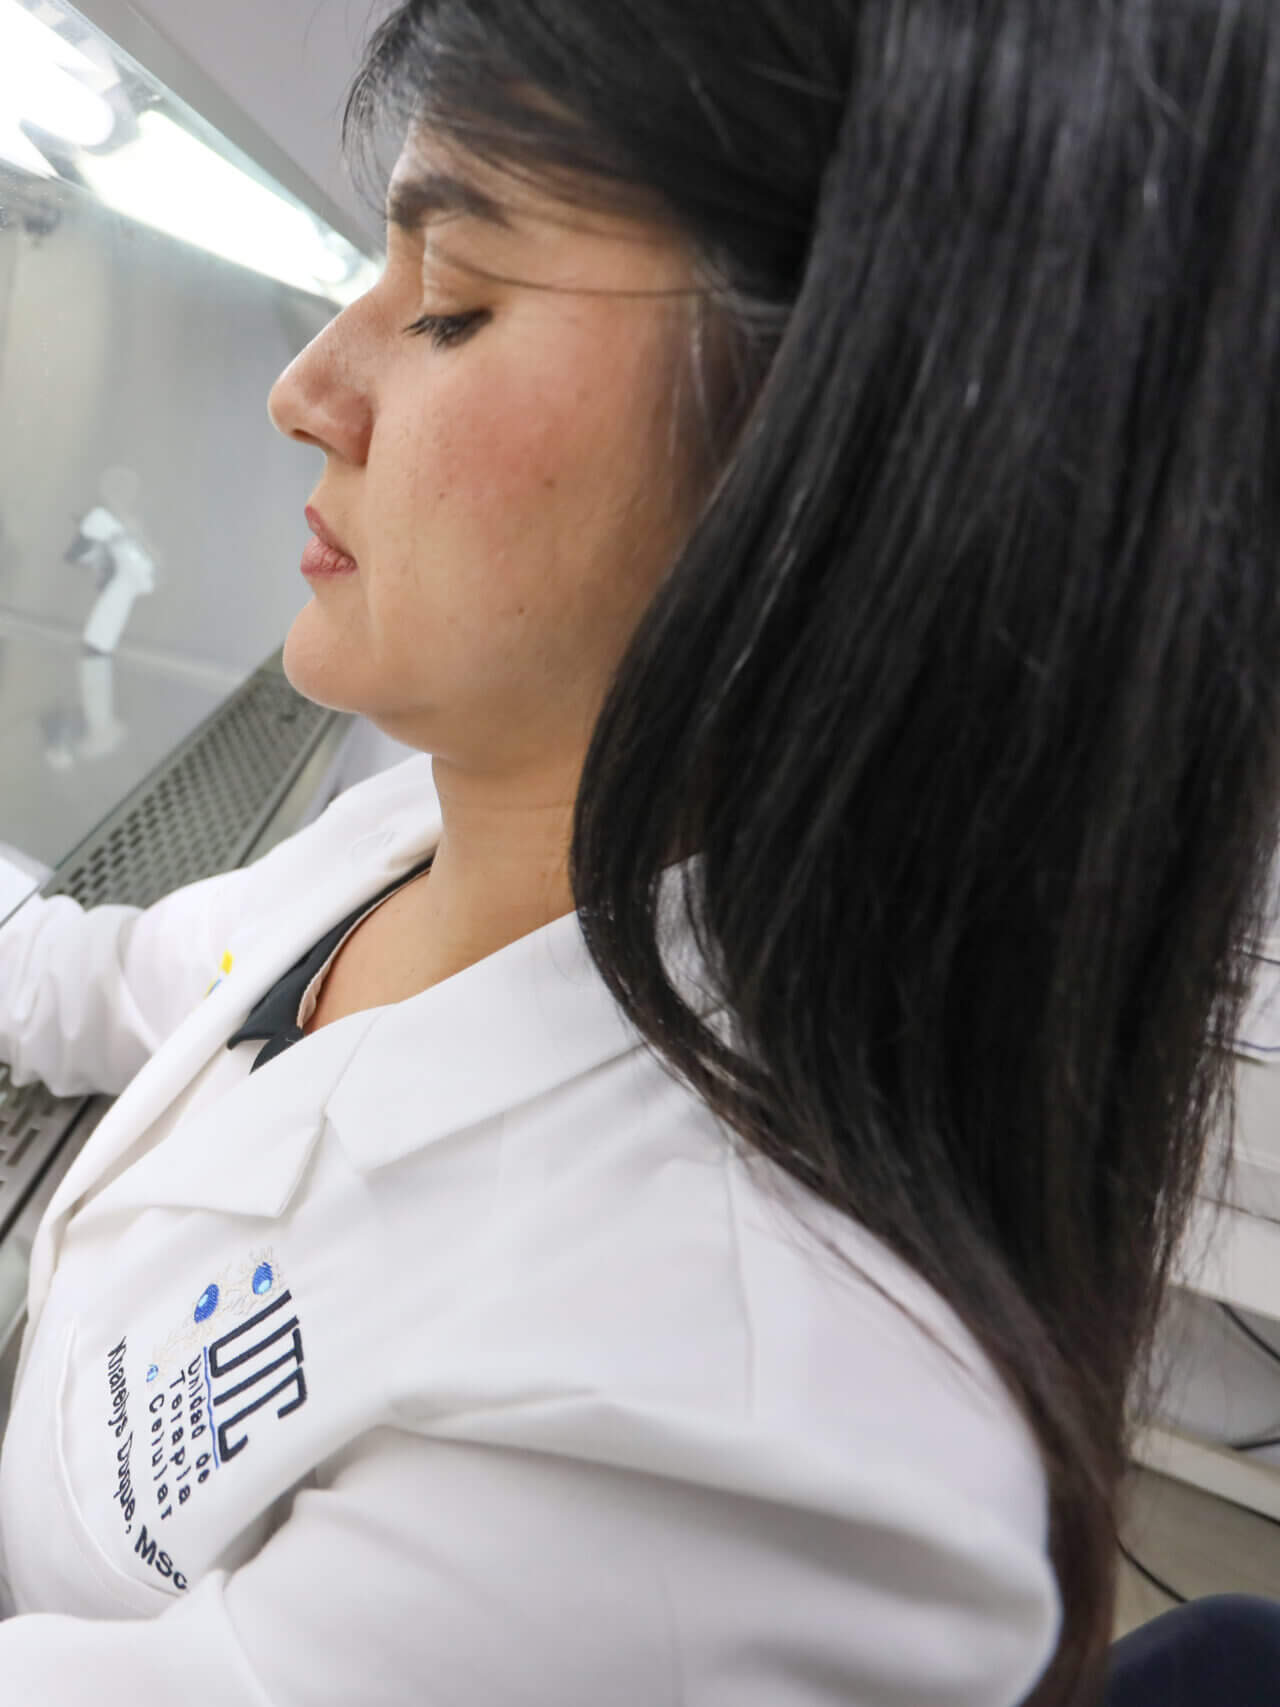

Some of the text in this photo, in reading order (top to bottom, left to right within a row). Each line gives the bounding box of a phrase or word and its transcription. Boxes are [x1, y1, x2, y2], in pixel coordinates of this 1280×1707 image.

[169, 1370, 192, 1505] Terapia
[187, 1353, 211, 1484] Unidad de
[208, 1289, 307, 1463] UTC
[148, 1393, 174, 1520] Celular
[133, 1524, 188, 1590] MSc
